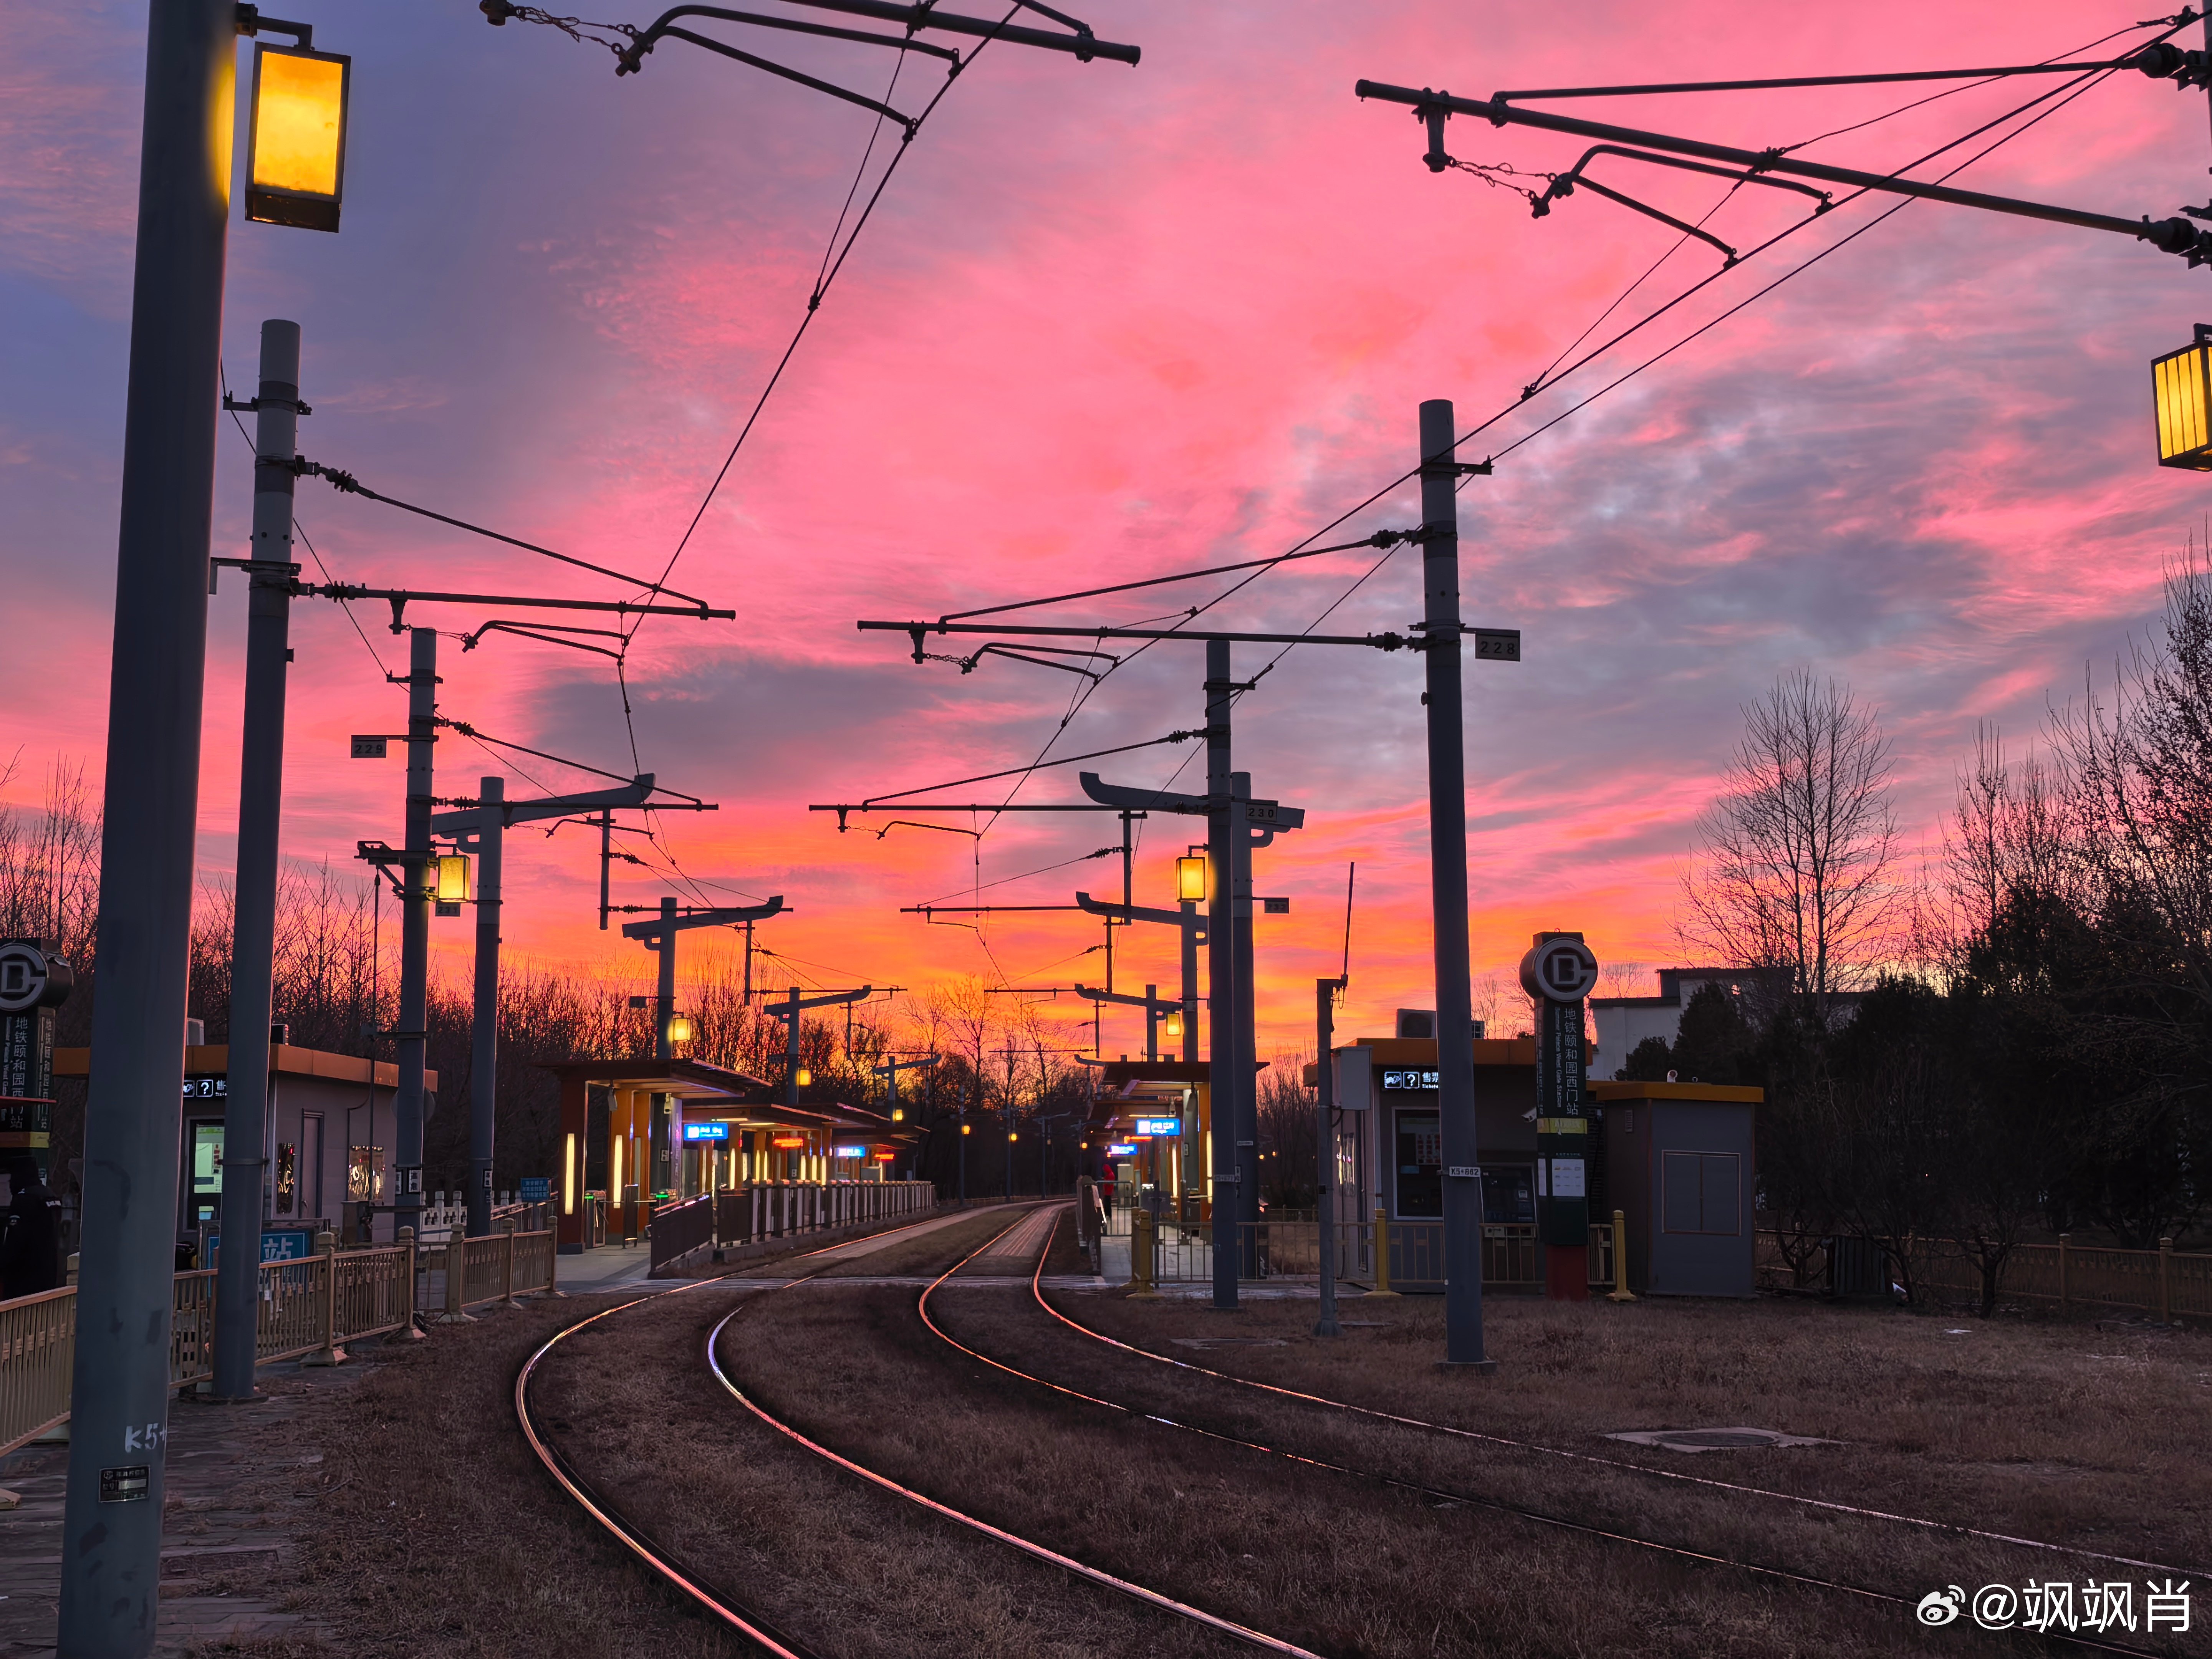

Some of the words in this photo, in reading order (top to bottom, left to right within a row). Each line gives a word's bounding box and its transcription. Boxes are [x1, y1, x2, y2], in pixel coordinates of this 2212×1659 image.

[1480, 641, 1515, 654] 228
[354, 745, 383, 754] 229
[1248, 808, 1274, 818] 230
[1564, 1008, 1578, 1115] 地铁颐和园西门站
